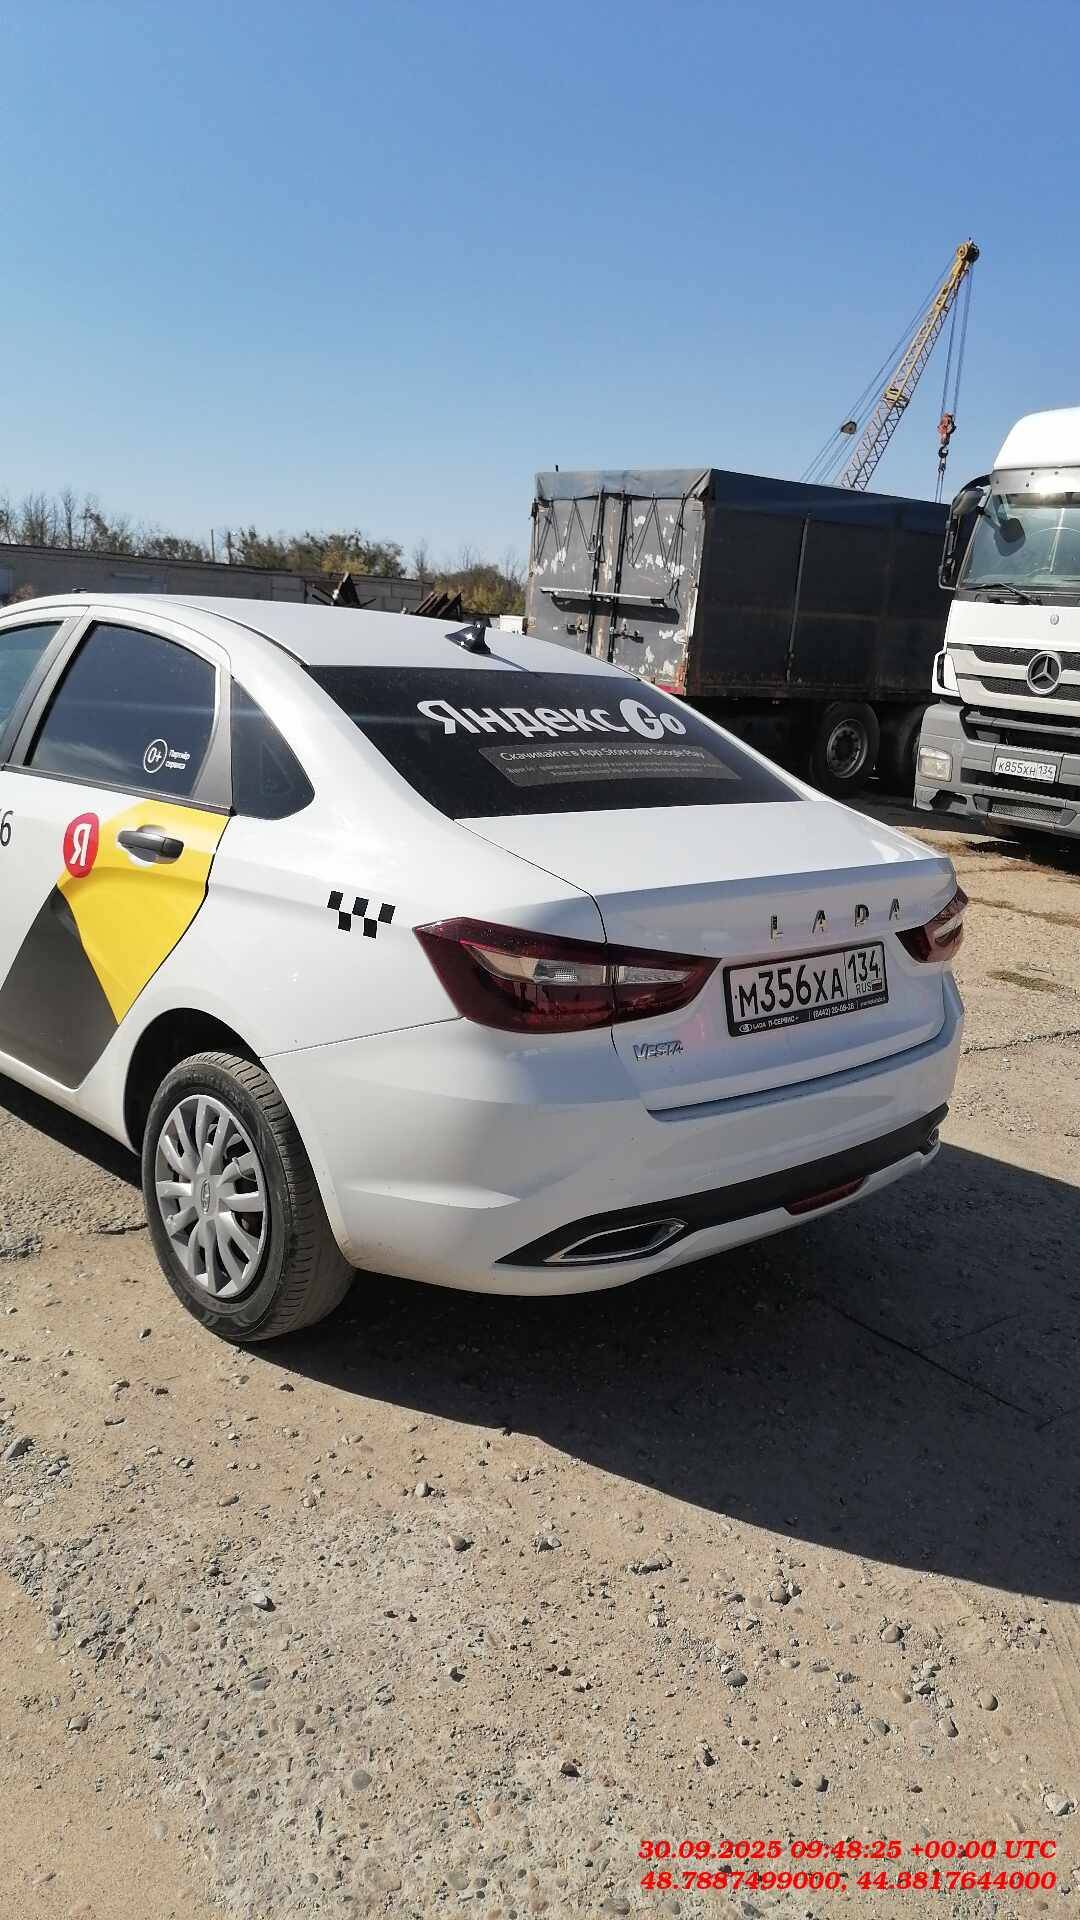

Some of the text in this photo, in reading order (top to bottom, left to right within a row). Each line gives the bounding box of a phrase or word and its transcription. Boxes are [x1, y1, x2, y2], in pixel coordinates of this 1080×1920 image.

[417, 698, 687, 740] Яндекс Go
[69, 822, 92, 867] Я
[770, 898, 901, 942] LADA
[738, 949, 881, 1018] М356ХА 134
[856, 981, 872, 995] RUS
[633, 1040, 684, 1062] VESTA
